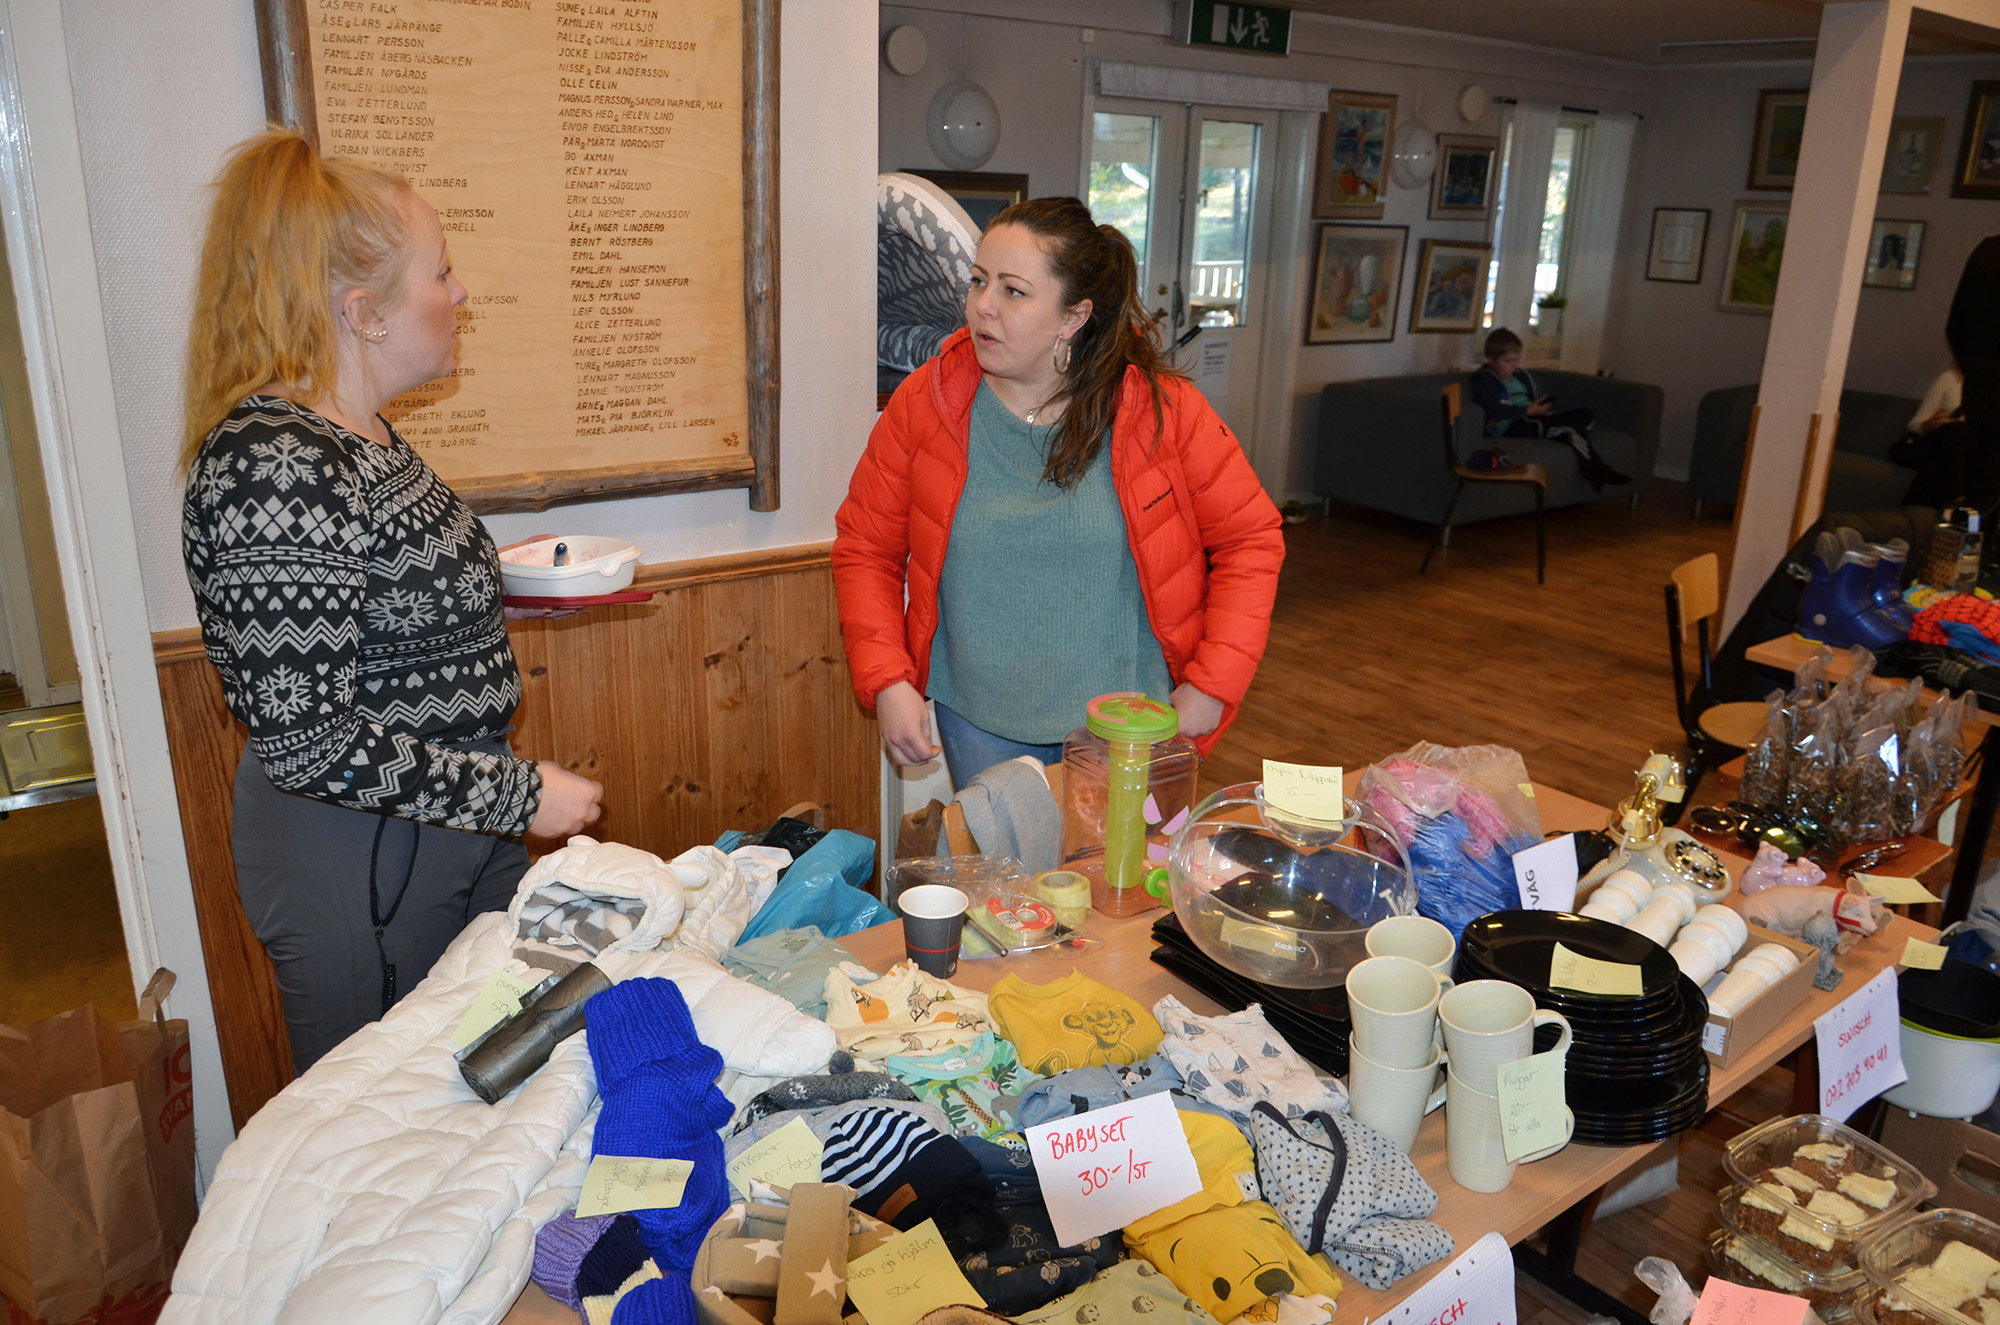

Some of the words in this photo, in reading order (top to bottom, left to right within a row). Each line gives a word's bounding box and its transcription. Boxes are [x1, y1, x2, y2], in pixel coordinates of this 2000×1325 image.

[319, 0, 364, 12] CASPER
[371, 3, 398, 14] FALK
[501, 1, 531, 11] BODIN
[556, 3, 579, 13] SUNE
[588, 5, 616, 16] LAILA
[321, 14, 342, 26] ÅSE
[353, 17, 381, 29] LARS
[386, 19, 443, 33] JÄRPÄNGE
[556, 17, 603, 30] FAMILJEN
[610, 22, 654, 33] HYLLSJÖ
[322, 33, 370, 44] LENNART
[377, 36, 424, 48] PERSSON
[556, 32, 586, 44] PALLE
[594, 35, 631, 47] CAMILLA
[323, 49, 374, 61] FAMILJEN
[380, 50, 412, 63] ÅBERG
[558, 47, 588, 59] JOCKE
[594, 50, 648, 62] LINDSTRÖM
[324, 65, 374, 77] FAMILJEN
[381, 66, 427, 80] NYGÅRDS
[558, 63, 585, 74] NISSE
[594, 64, 611, 75] EVA
[616, 67, 670, 79] ANDERSSON
[324, 81, 372, 93] FAMILJEN
[381, 83, 428, 95] LUNDMAN
[560, 77, 584, 88] OLLE
[589, 79, 618, 90] CELIN
[326, 97, 346, 107] EVA
[357, 98, 427, 111] ZETTERLUND
[558, 93, 592, 104] MAGNUS
[594, 94, 631, 105] PERSSON
[635, 96, 666, 107] SANDRA
[706, 100, 723, 110] MAX
[328, 113, 368, 124] STEFAN
[373, 115, 435, 127] BENGTSSON
[558, 108, 593, 118] ANDERS
[595, 109, 613, 120] HED
[621, 110, 650, 120] HELEN
[654, 111, 674, 121] LIND
[562, 121, 588, 132] EIVOR
[593, 123, 672, 135] ENGELBREKTSSON
[331, 129, 369, 139] ULRIKA
[376, 130, 434, 142] SOLLANDER
[562, 135, 581, 146] PÄR
[620, 139, 666, 149] NORDQVIST
[334, 145, 368, 155] URBAN
[564, 152, 576, 161] BO
[584, 153, 615, 162] AXMAN
[566, 167, 593, 176] KENT
[596, 168, 628, 177] AXMAN
[419, 178, 468, 188] LINDBERG
[565, 181, 605, 190] LENNART
[608, 180, 652, 191] HÄGGLUND
[566, 195, 588, 205] ERIK
[592, 196, 625, 205] OLSSON
[568, 210, 593, 218] LAILA
[598, 209, 637, 219] NEIMERT
[639, 210, 690, 219] JOHANSSON
[568, 221, 586, 232] ÅKE
[594, 223, 619, 233] INGER
[623, 223, 665, 232] LINDBERG
[570, 237, 601, 247] BERNT
[609, 236, 653, 247] RÖSTBERG
[572, 251, 595, 261] EMIL
[599, 251, 622, 260] DAHL
[570, 265, 613, 275] FAMILJEN
[619, 264, 667, 274] HANSEMON
[570, 279, 613, 289] FAMILJEN
[620, 278, 640, 288] LUST
[644, 277, 689, 287] SANNEFUR
[472, 295, 519, 305] OLOFSSON
[572, 293, 595, 302] NILS
[599, 292, 641, 302] MYRLUND
[573, 307, 594, 316] LEIF
[600, 306, 635, 316] OLSSON
[574, 320, 600, 330] ALICE
[607, 318, 662, 328] ZETTERLUND
[573, 334, 616, 344] FAMILJEN
[572, 346, 612, 357] ANNELIE
[616, 345, 660, 355] OLOFSSON
[575, 361, 597, 370] TURE
[603, 359, 647, 369] MARGRETH
[652, 356, 697, 366] OLOFSSON
[577, 373, 619, 383] LENNART
[624, 370, 676, 381] MAGNUSSON
[577, 387, 608, 397] DANNE
[389, 397, 436, 409] NYGÅRDS
[576, 401, 599, 411] ARNE
[606, 398, 641, 409] MAGGAN
[647, 396, 668, 405] DAHL
[389, 411, 443, 423] ELISABETH
[450, 409, 486, 420] EKLUND
[577, 414, 601, 424] MATS
[609, 412, 623, 422] PIA
[631, 409, 674, 420] BJÖRKLIN
[422, 426, 442, 436] ANN
[448, 423, 490, 433] GRANATH
[575, 427, 606, 437] MIKAEL
[659, 421, 678, 430] LILL
[683, 418, 715, 428] LARSEN
[440, 436, 478, 448] BJÄRNE
[1525, 869, 1541, 908] VÅG
[1046, 1115, 1135, 1160] BABYSET
